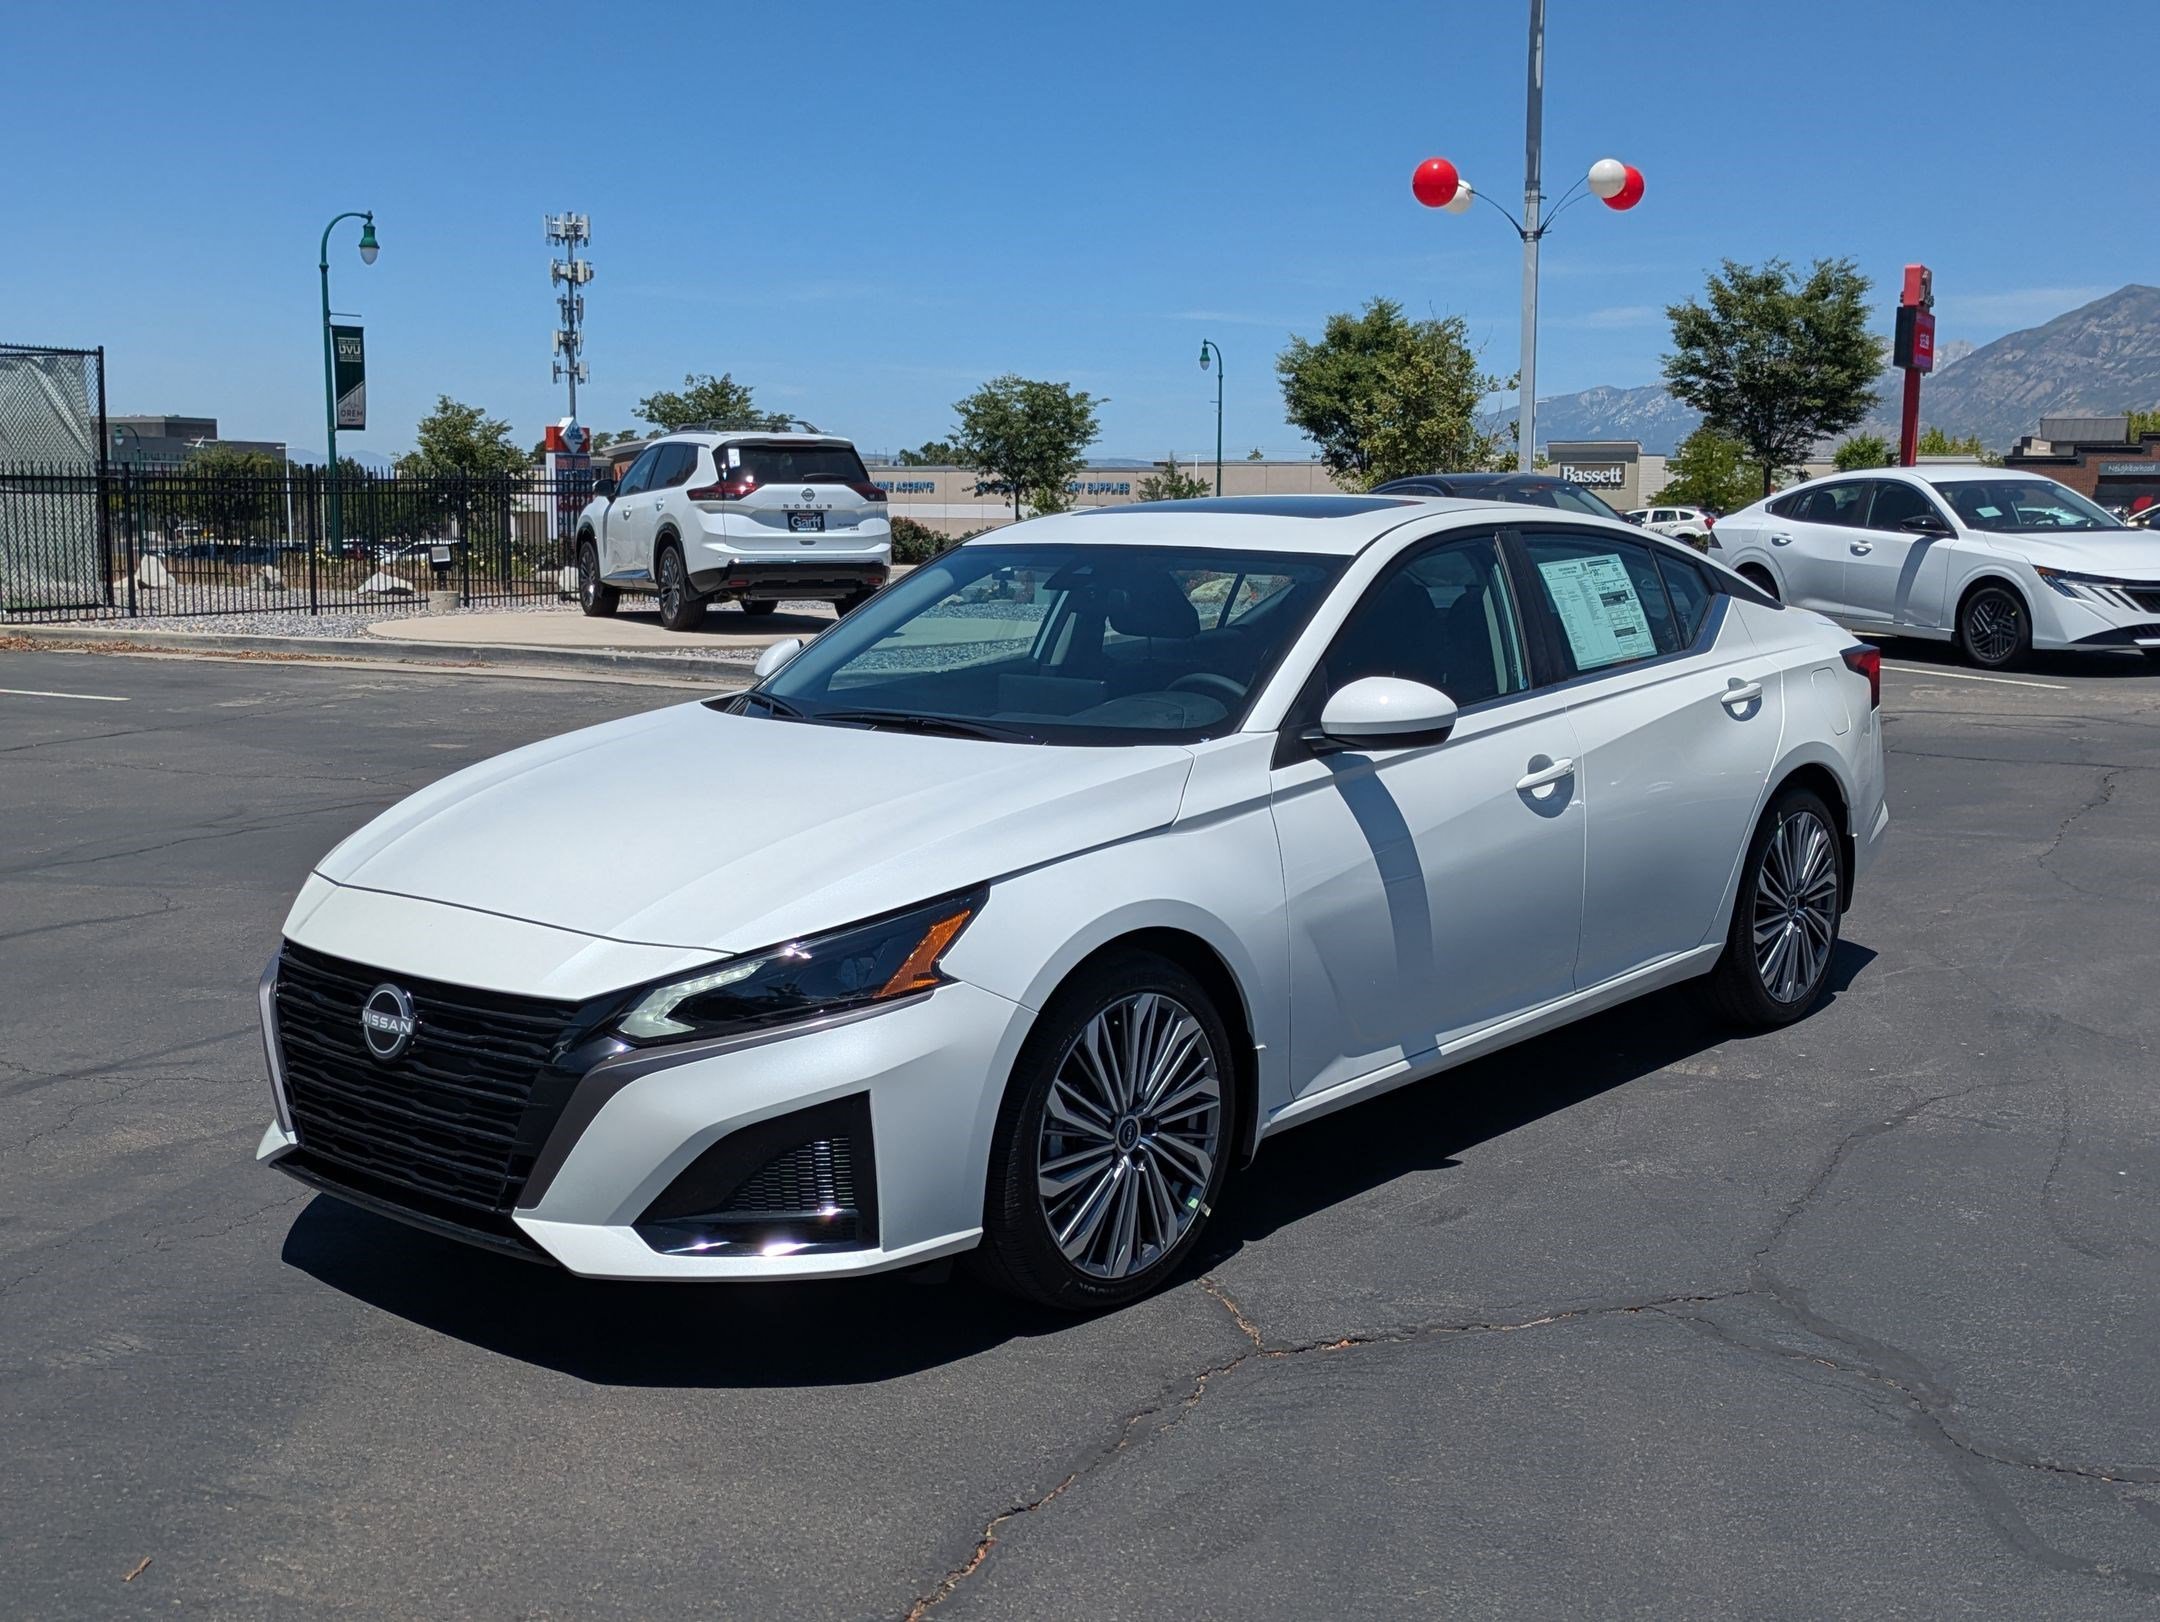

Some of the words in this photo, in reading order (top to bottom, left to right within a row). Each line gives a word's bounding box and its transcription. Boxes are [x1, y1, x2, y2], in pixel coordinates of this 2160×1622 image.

[340, 409, 363, 418] OREM
[1562, 466, 1622, 483] Bassett
[896, 481, 935, 492] ACCENTS
[1087, 482, 1130, 494] SUPPLIES
[790, 515, 822, 529] Garff
[362, 1009, 412, 1033] NISSAN
